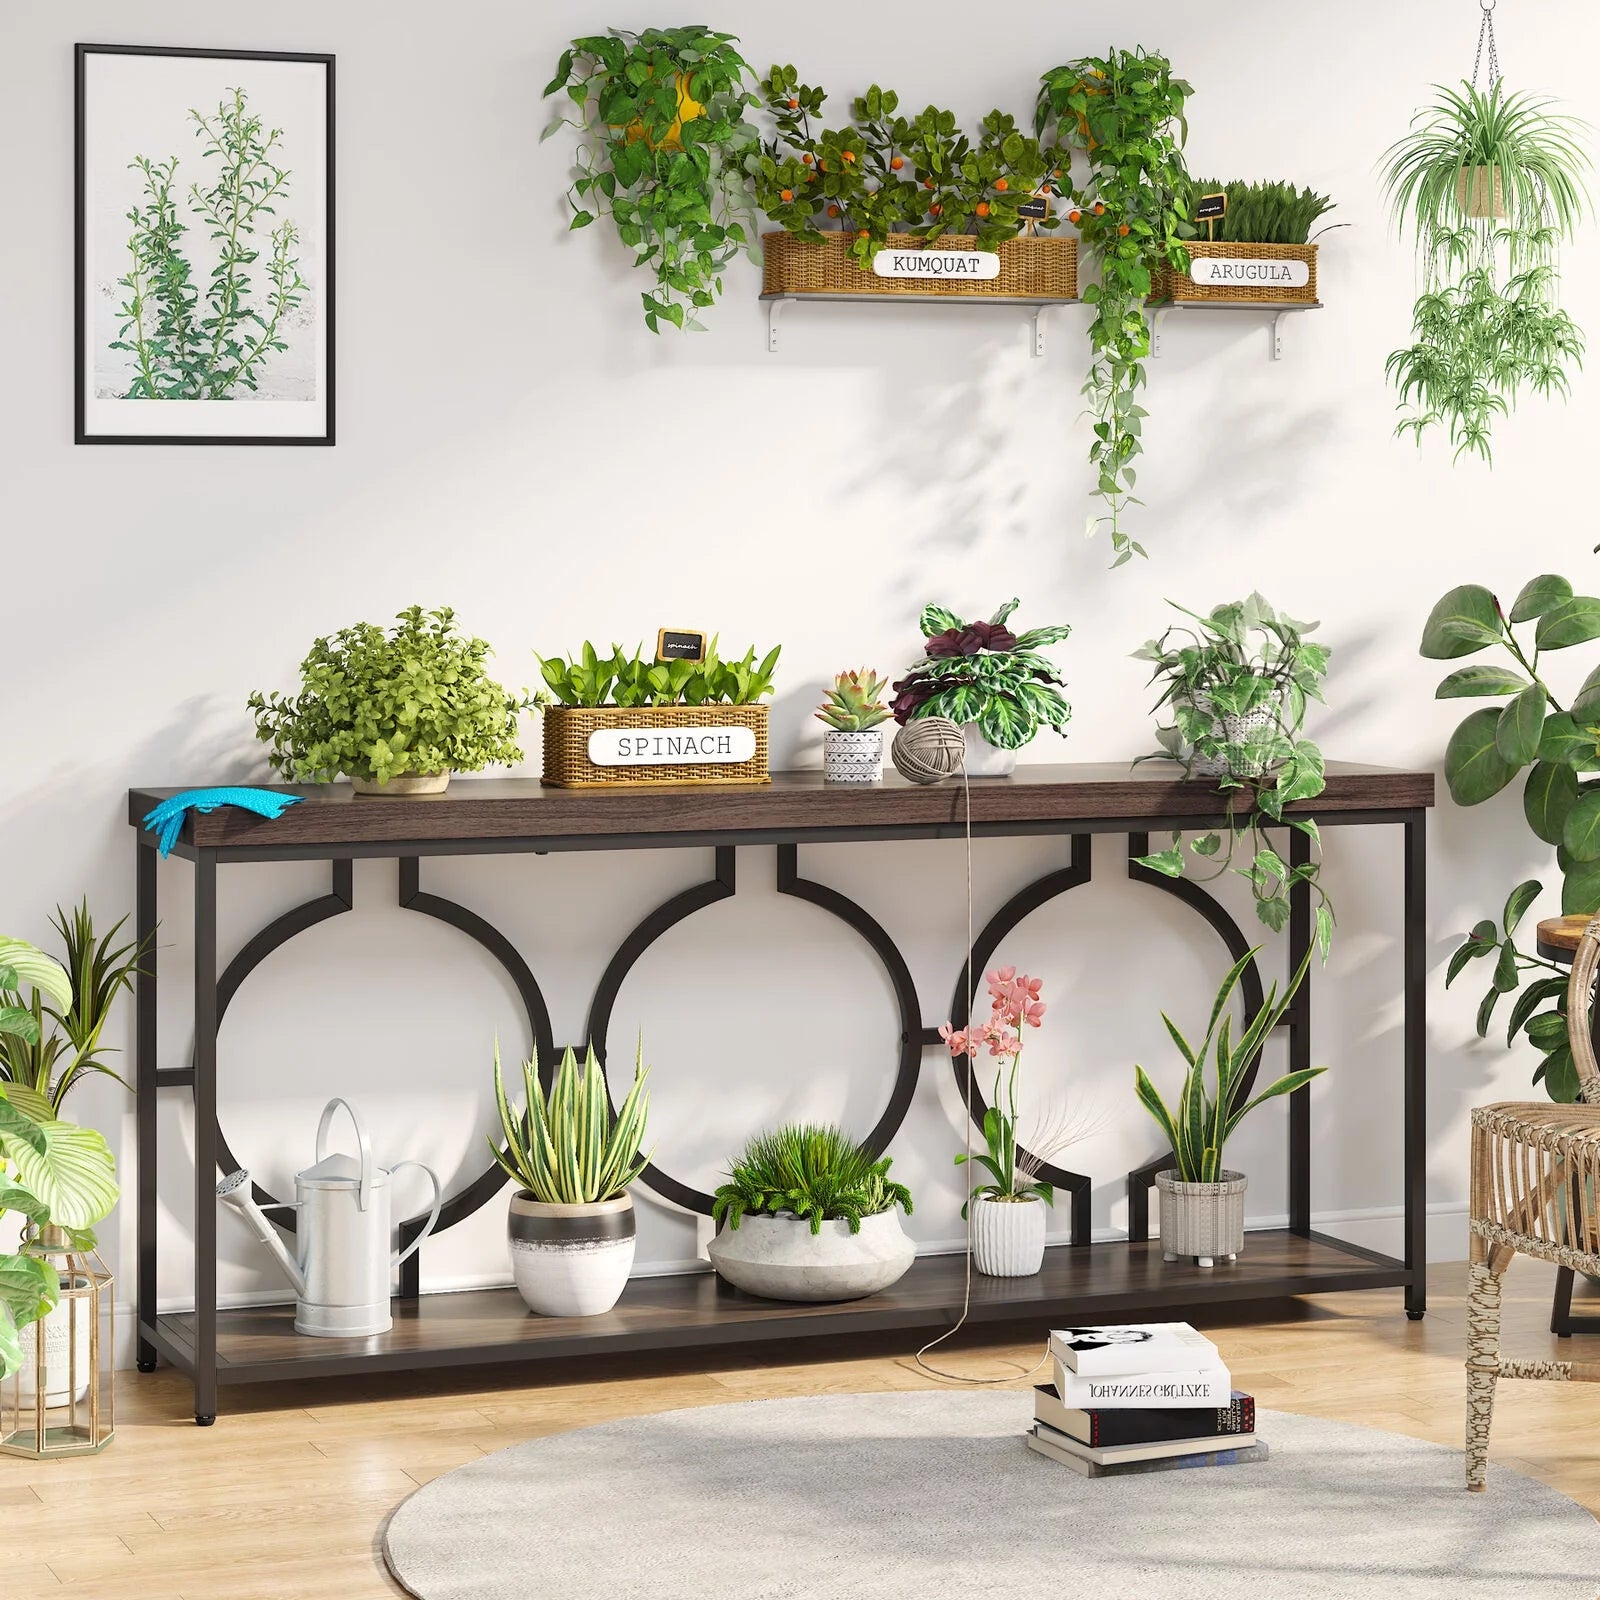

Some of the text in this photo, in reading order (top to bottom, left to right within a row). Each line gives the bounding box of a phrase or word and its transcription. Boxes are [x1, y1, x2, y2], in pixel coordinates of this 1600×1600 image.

[892, 256, 980, 274] KUMQUAT
[1210, 264, 1293, 281] ARUGULA
[667, 642, 698, 650] spinach
[618, 735, 732, 757] SPINACH
